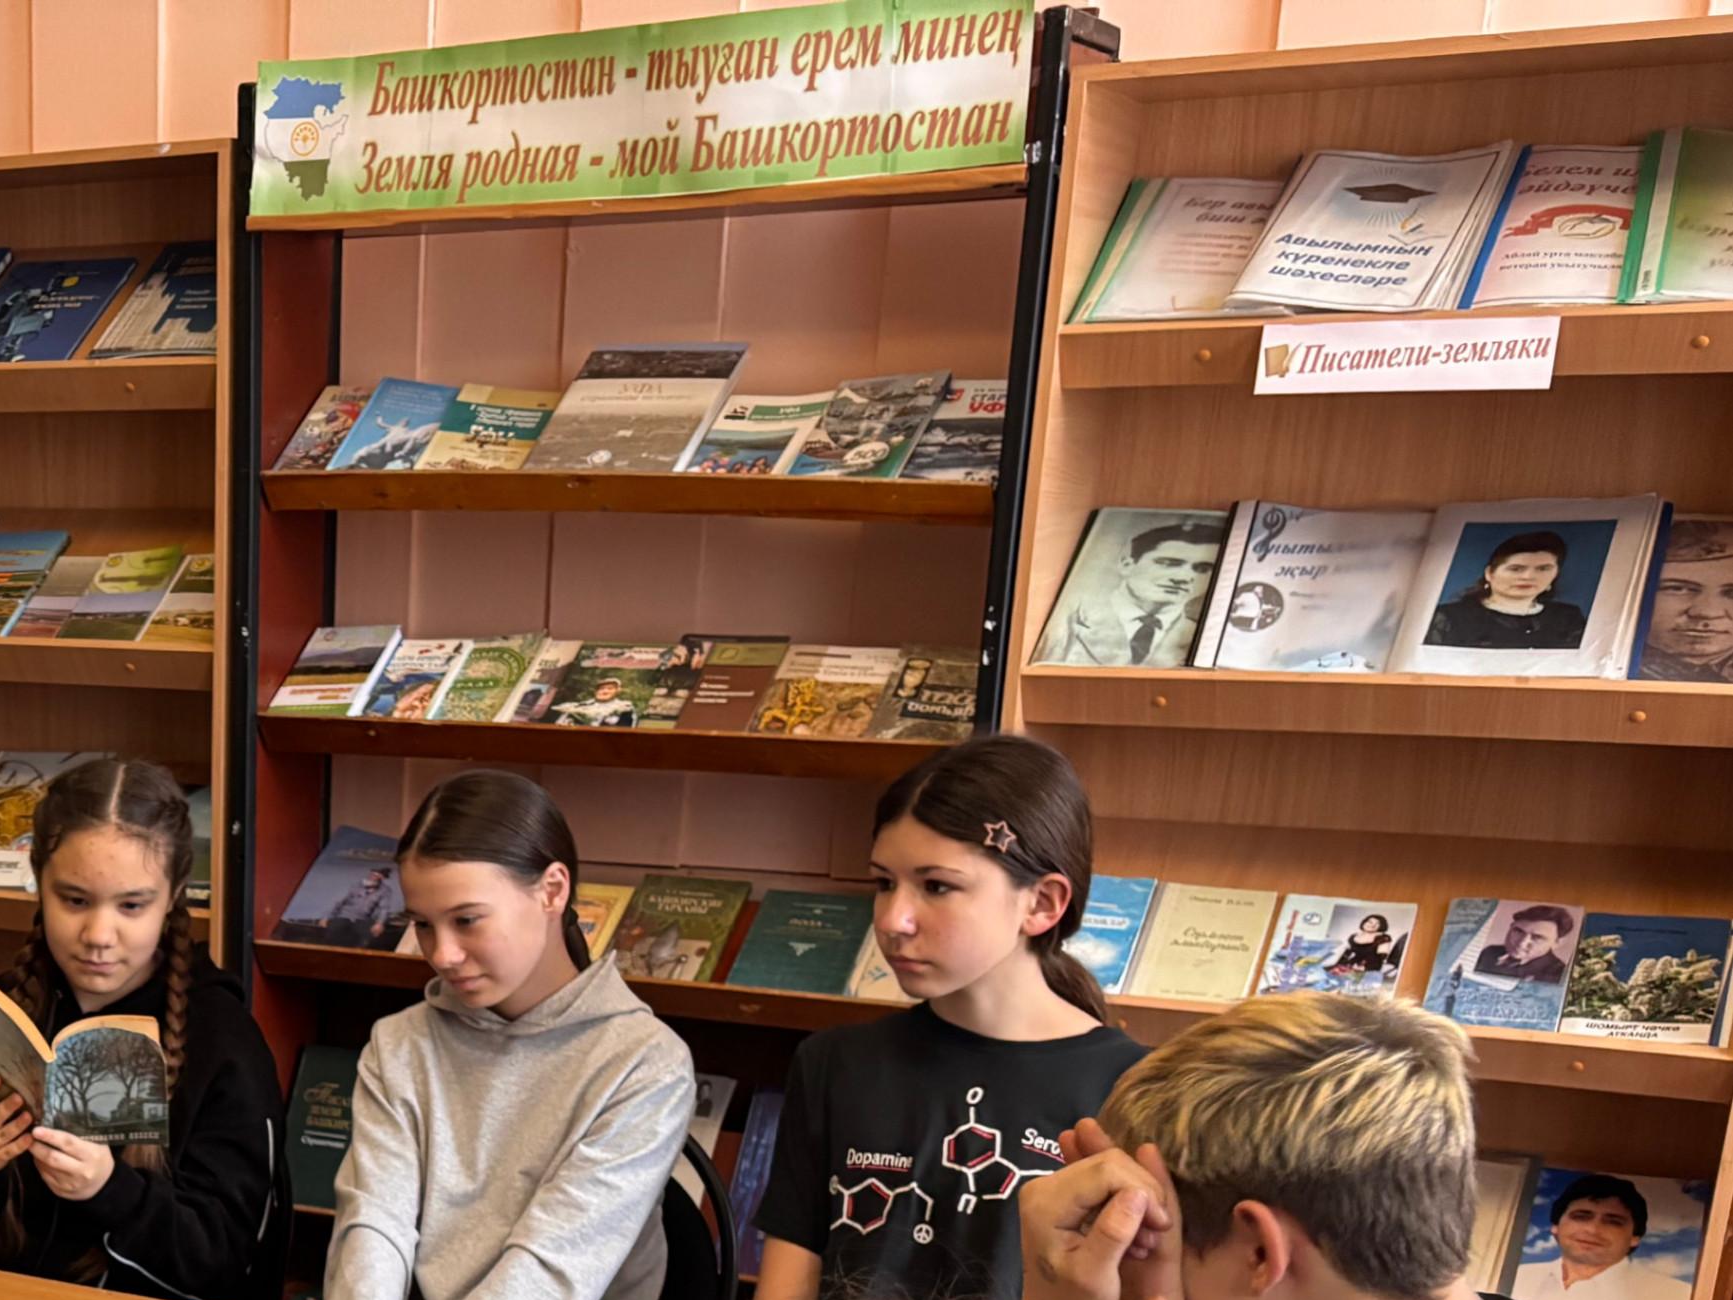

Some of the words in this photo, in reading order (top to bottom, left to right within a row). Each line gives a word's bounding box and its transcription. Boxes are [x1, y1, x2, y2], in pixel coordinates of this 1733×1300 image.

[791, 23, 883, 91] ерем
[355, 141, 454, 194] Земля
[456, 130, 581, 204] родная
[609, 118, 681, 179] мой
[690, 101, 1013, 177] Башкортостан
[1297, 336, 1552, 375] Писатели-земляки
[1021, 1127, 1065, 1157] Sero
